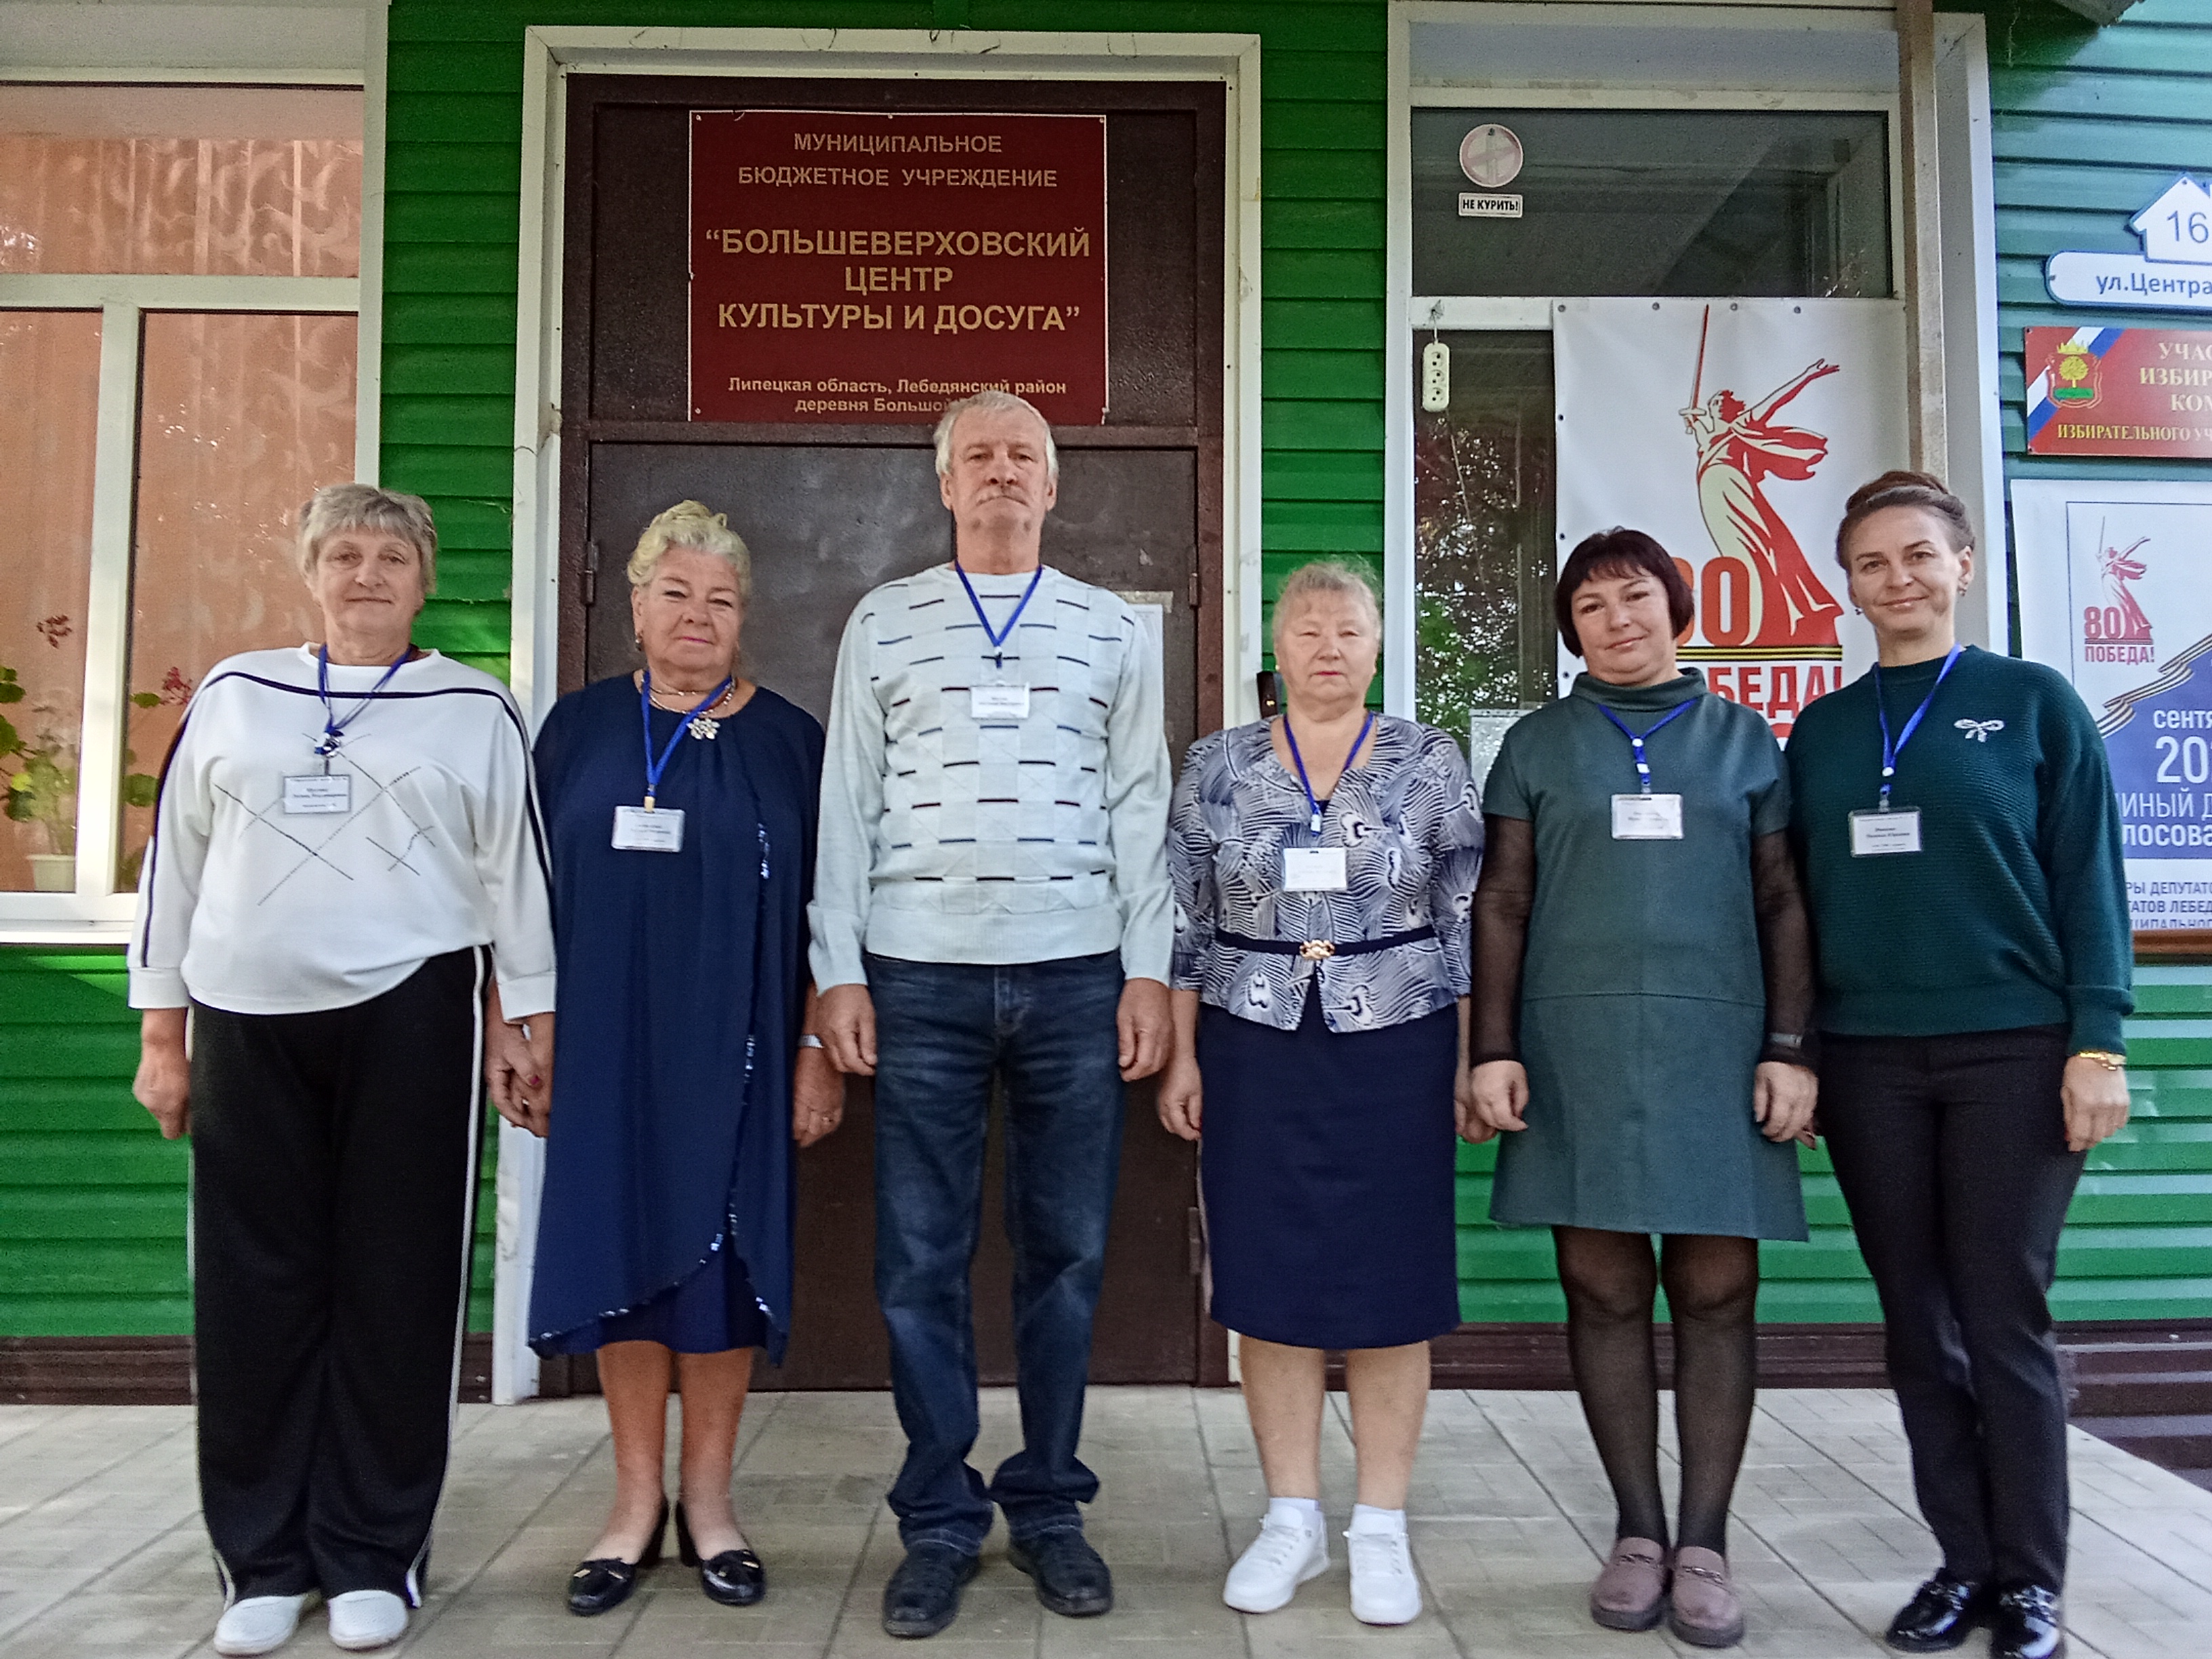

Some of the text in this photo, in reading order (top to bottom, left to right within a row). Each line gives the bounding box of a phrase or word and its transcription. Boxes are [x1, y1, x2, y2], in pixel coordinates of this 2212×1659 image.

[794, 133, 1002, 155] МУНИЦИПАЛЬНОЕ
[738, 166, 1057, 188] БЮДЖЕТНОЕ УЧРЕЖДЕНИЕ
[1462, 199, 1518, 211] НЕ КУРИТЬ!
[2167, 210, 2209, 243] 16
[705, 227, 1090, 257] “БОЛЬШЕВЕРХОВСКИЙ
[845, 266, 954, 295] ЦЕНТР
[718, 303, 1080, 335] КУЛЬТУРЫ И ДОСУГА”
[729, 377, 1066, 396] Липецкая область, Лебедянский район
[795, 398, 869, 413] деревня
[2058, 424, 2190, 441] ИЗБИРАТЕЛЬНОГО
[2084, 607, 2121, 639] 80
[2085, 646, 2155, 665] ПОБЕДА!
[2155, 736, 2212, 784] 20
[2115, 787, 2194, 817] ИНЫЙ
[2150, 882, 2212, 896] ДЕПУТАТ
